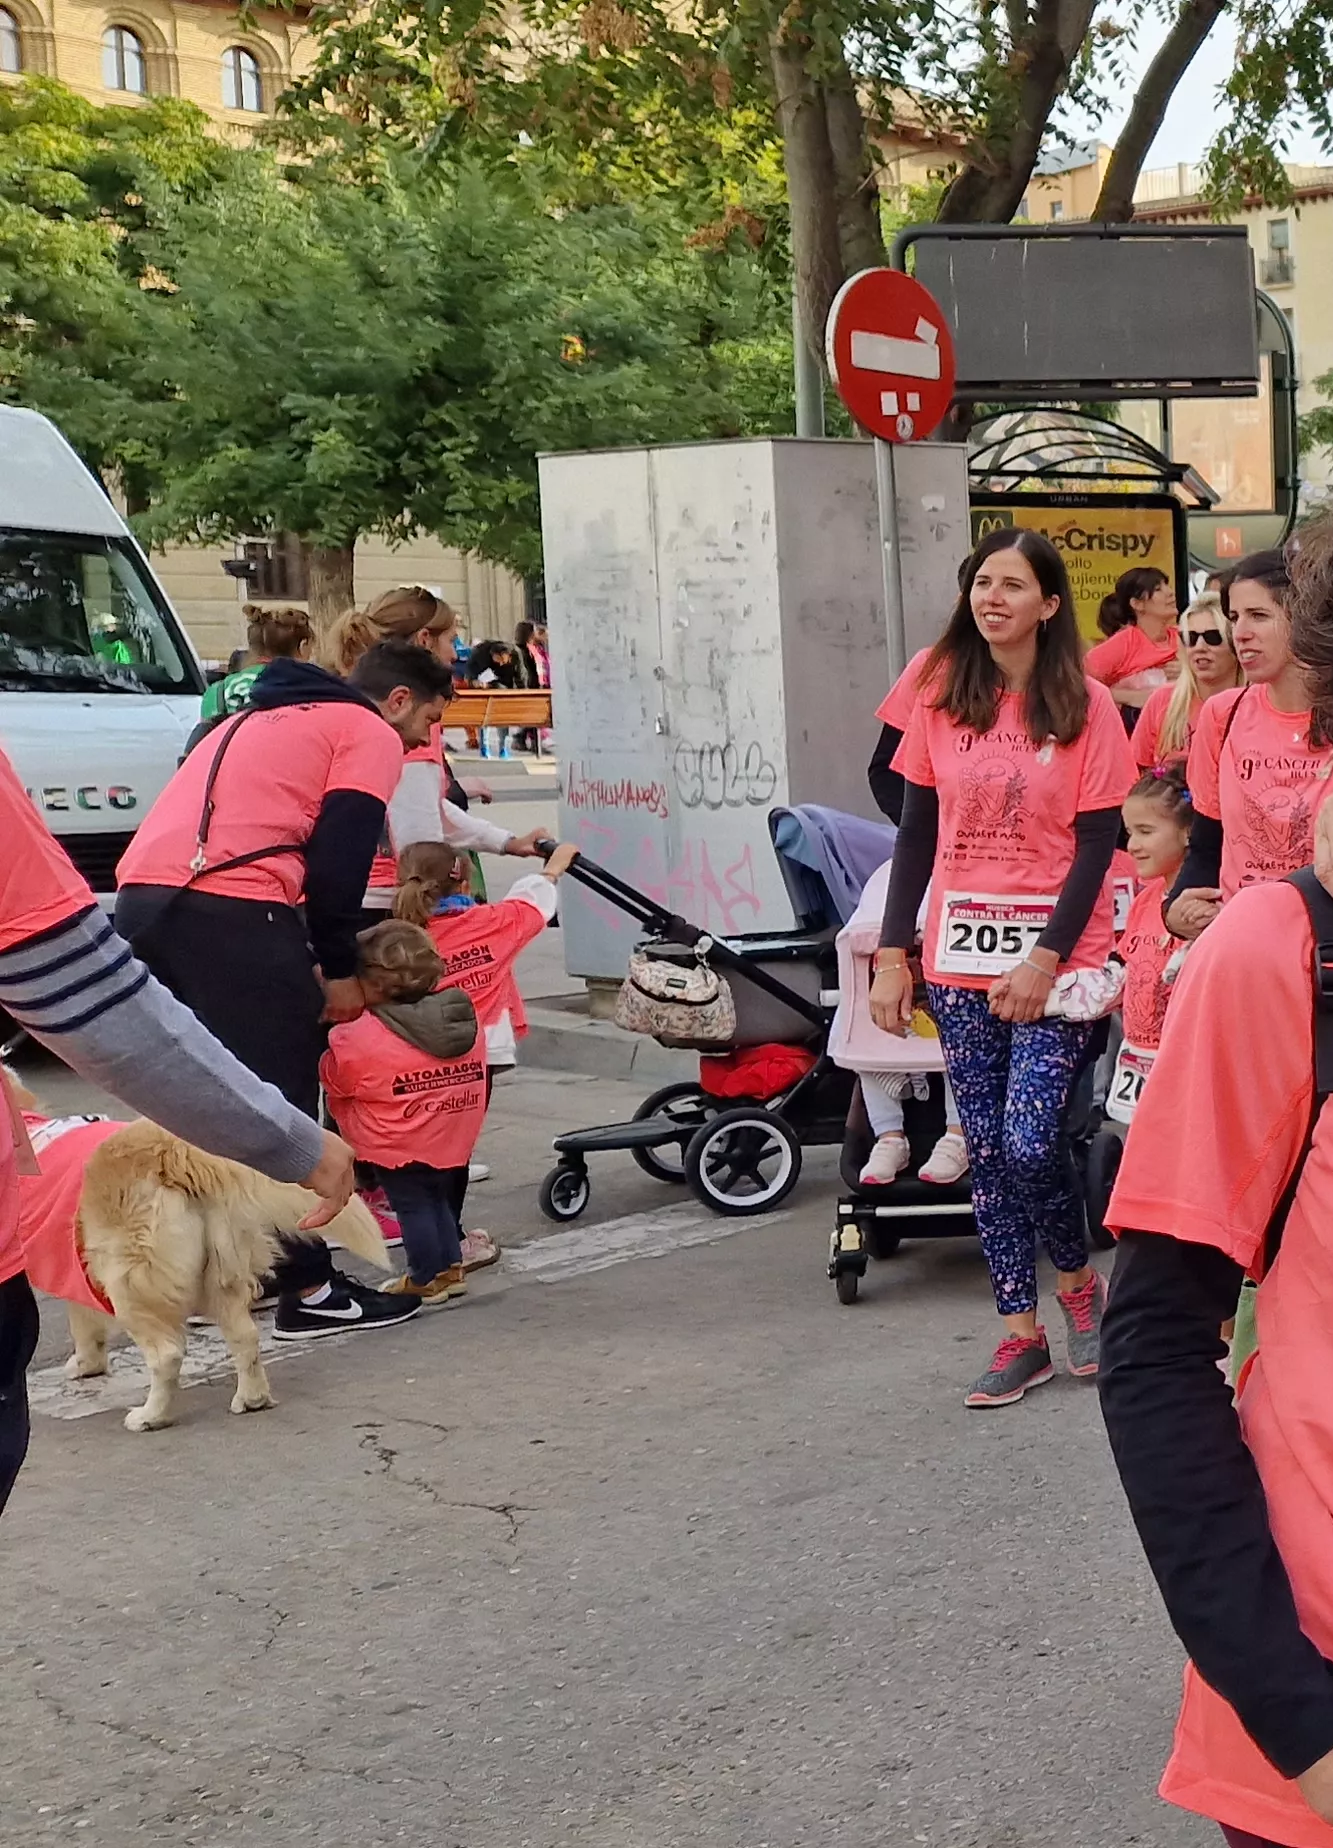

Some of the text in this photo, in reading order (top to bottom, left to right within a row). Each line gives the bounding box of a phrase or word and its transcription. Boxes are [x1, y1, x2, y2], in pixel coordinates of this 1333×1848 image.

[1043, 527, 1155, 557] cCrispy
[1066, 557, 1092, 569] ollo
[27, 786, 137, 811] ECO
[953, 908, 1049, 921] CONTRA EL CÁNCER
[392, 1058, 483, 1086] ALTOARAGÓN
